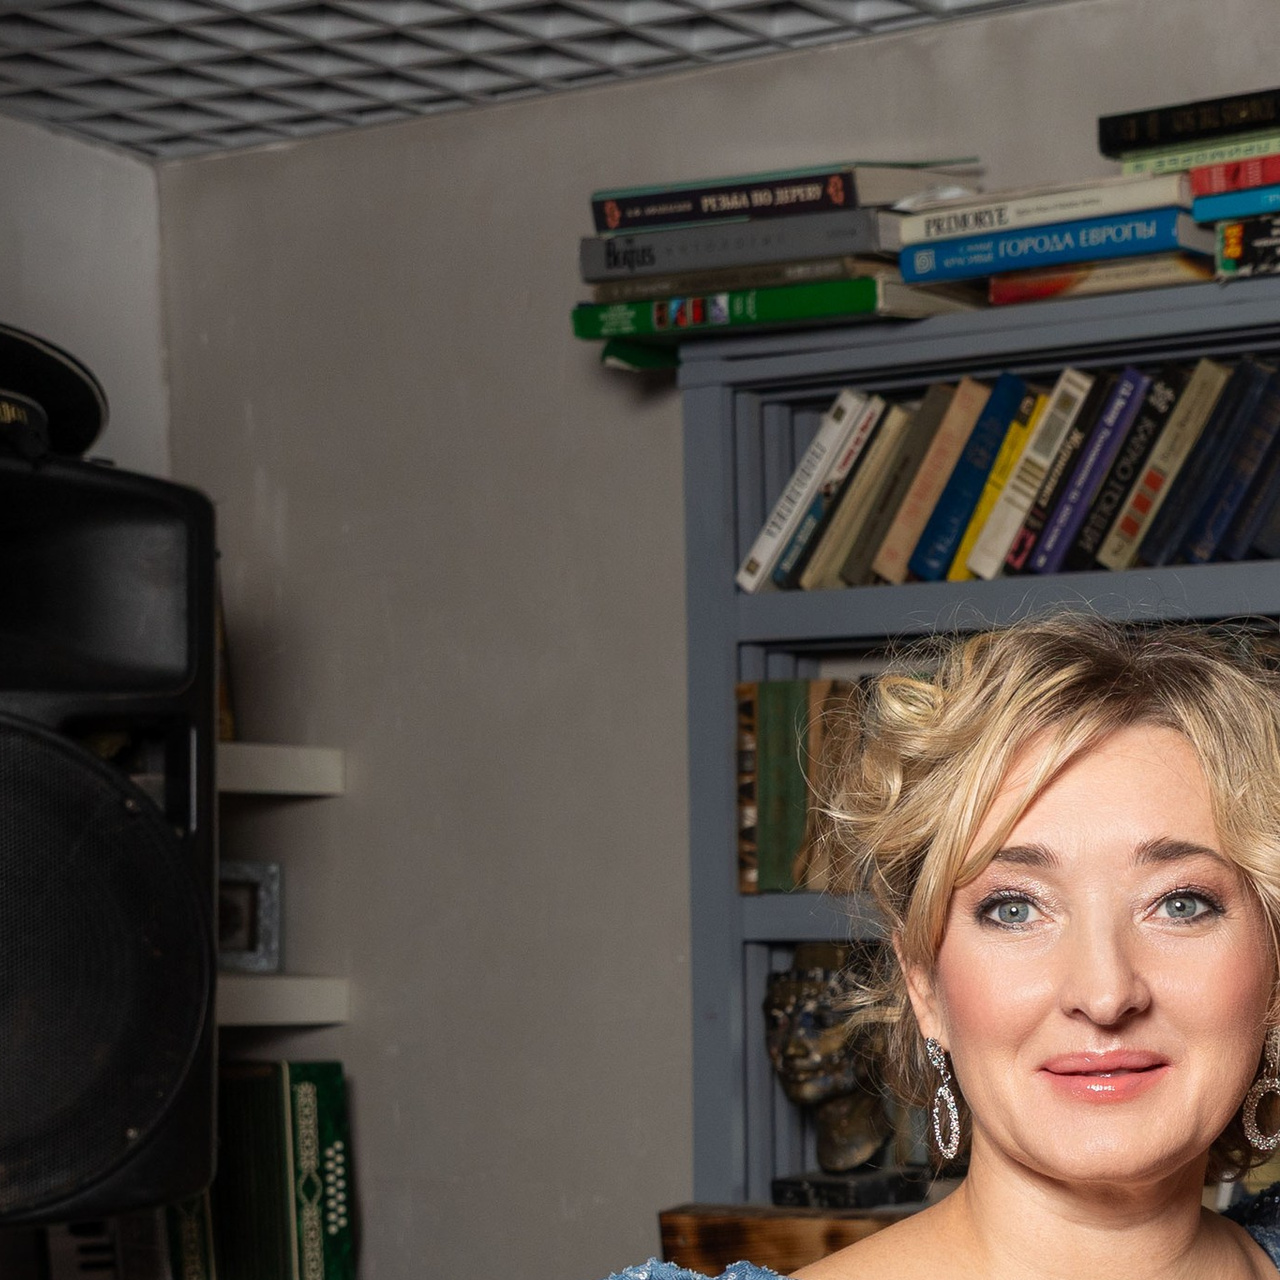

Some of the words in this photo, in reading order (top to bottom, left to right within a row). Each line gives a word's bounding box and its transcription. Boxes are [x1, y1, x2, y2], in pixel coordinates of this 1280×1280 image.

[924, 205, 1010, 237] PRIMORYE
[998, 230, 1075, 258] ГОРОДА
[1078, 220, 1157, 248] ЕВРОПЫ
